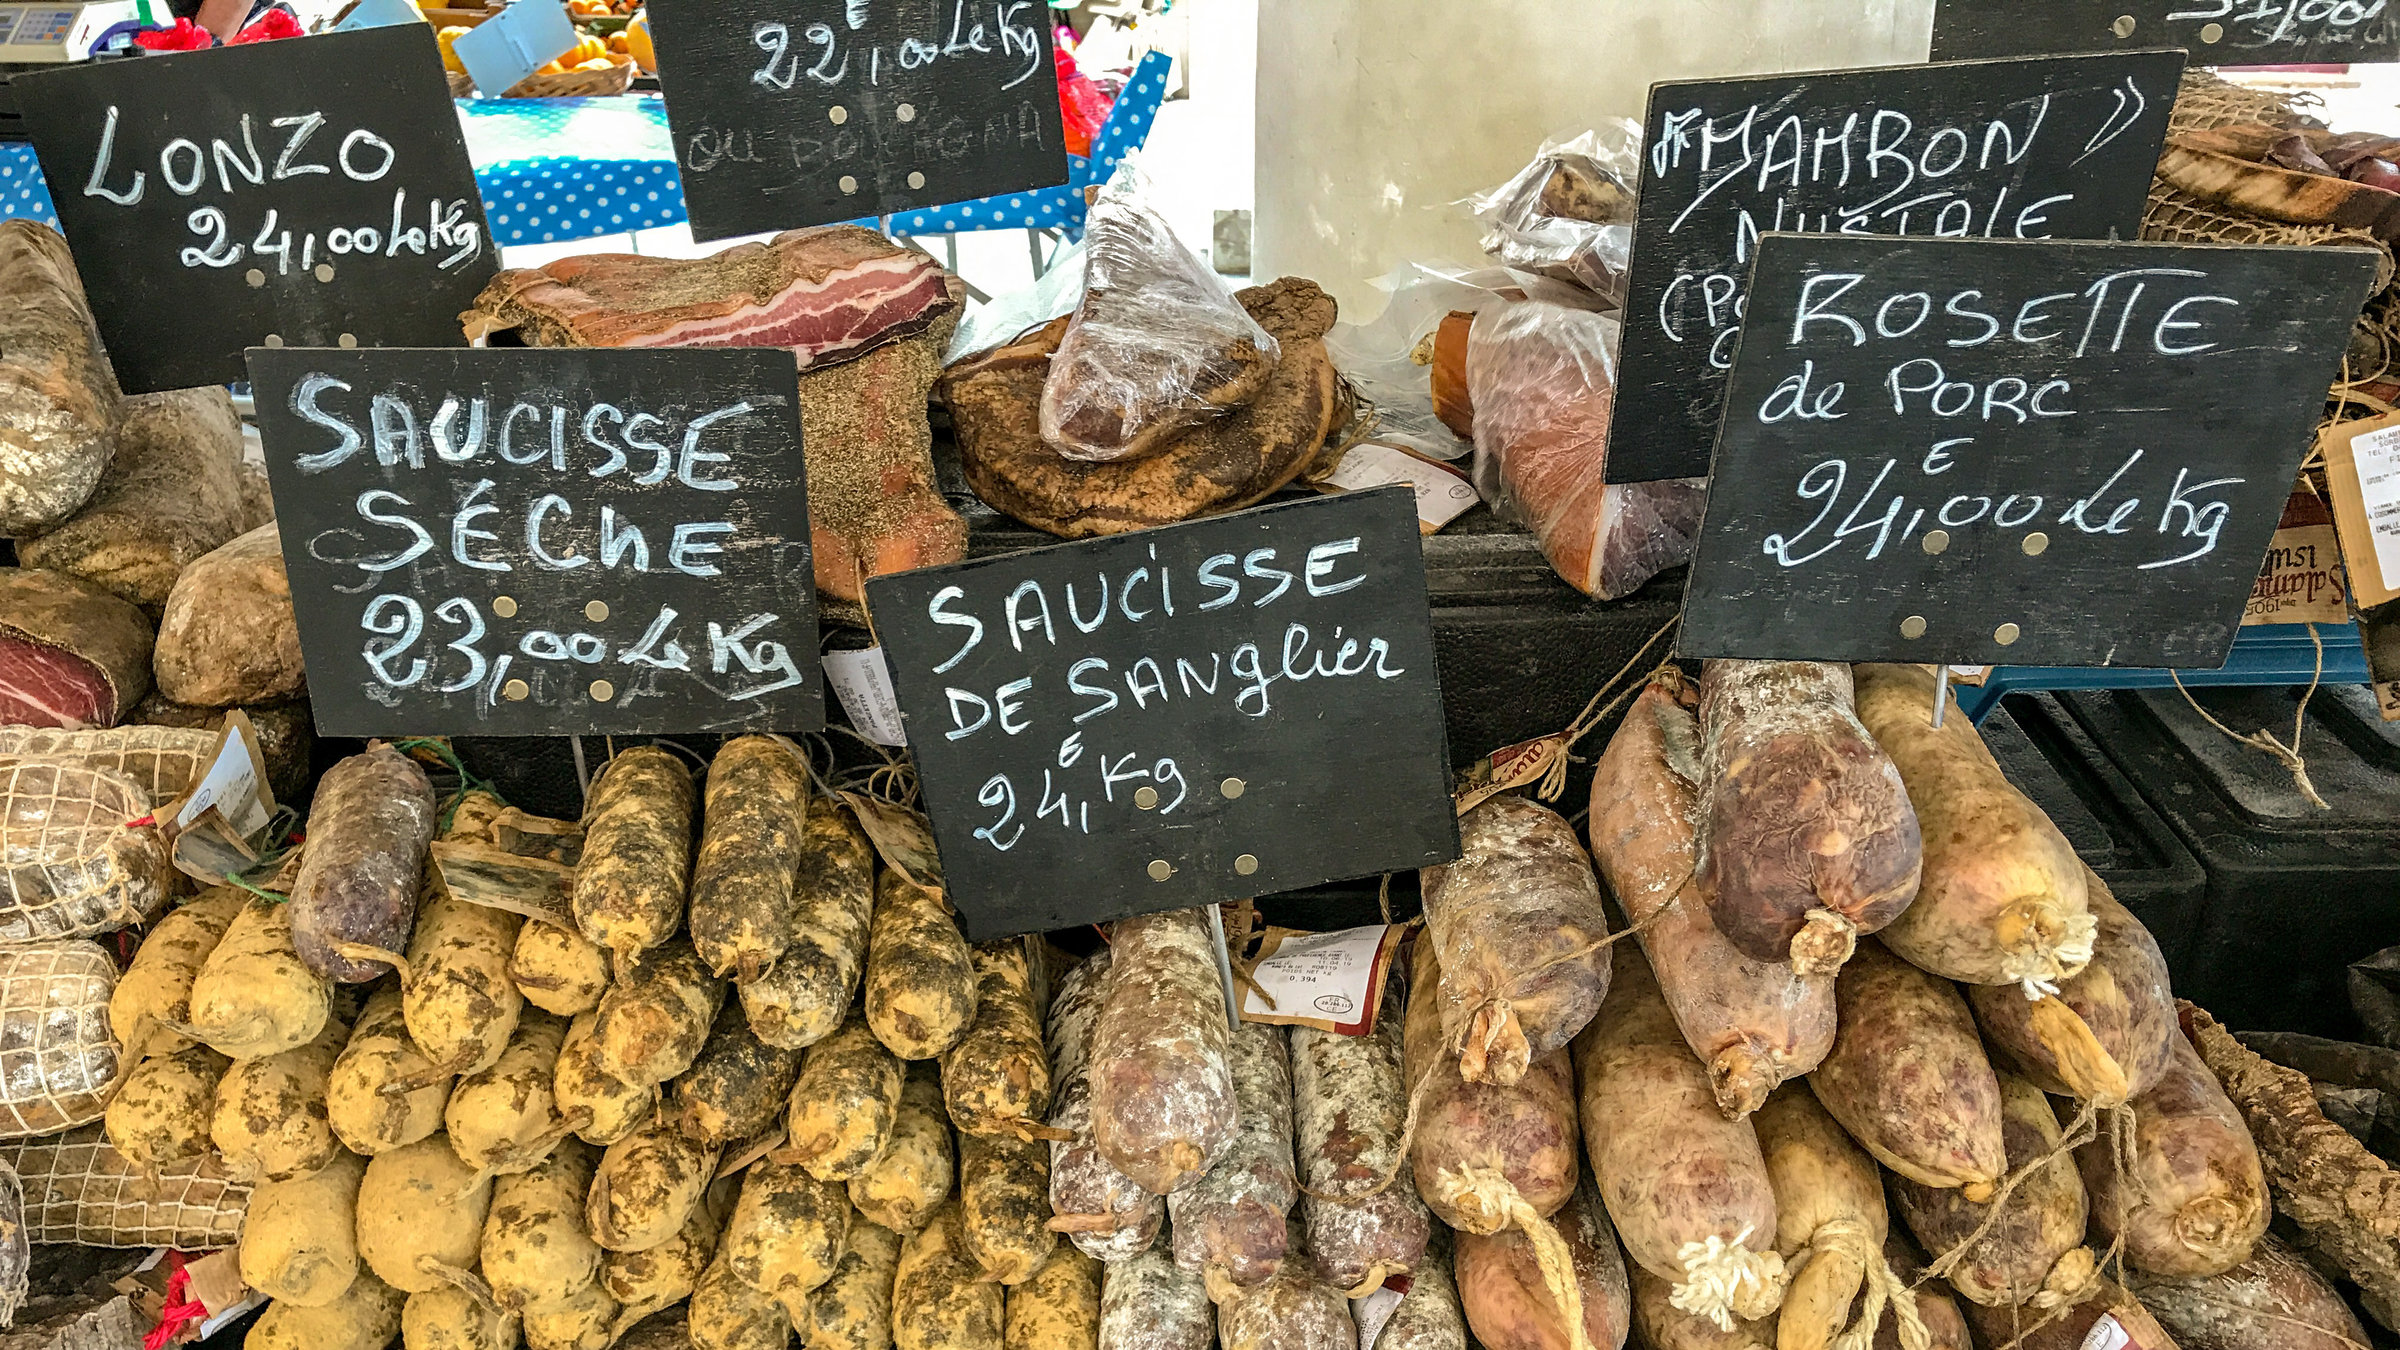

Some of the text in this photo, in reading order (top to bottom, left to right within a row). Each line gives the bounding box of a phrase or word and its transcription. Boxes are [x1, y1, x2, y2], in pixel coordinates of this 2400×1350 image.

[84, 105, 395, 205] LONZO
[181, 206, 382, 275] 24,00
[1792, 269, 2238, 357] ROSETTE
[293, 371, 757, 491] SAUCISSE
[1758, 357, 2077, 423] de PORC
[1763, 459, 2043, 567] 24,00
[361, 593, 607, 706] 23,00
[943, 675, 1034, 742] DE
